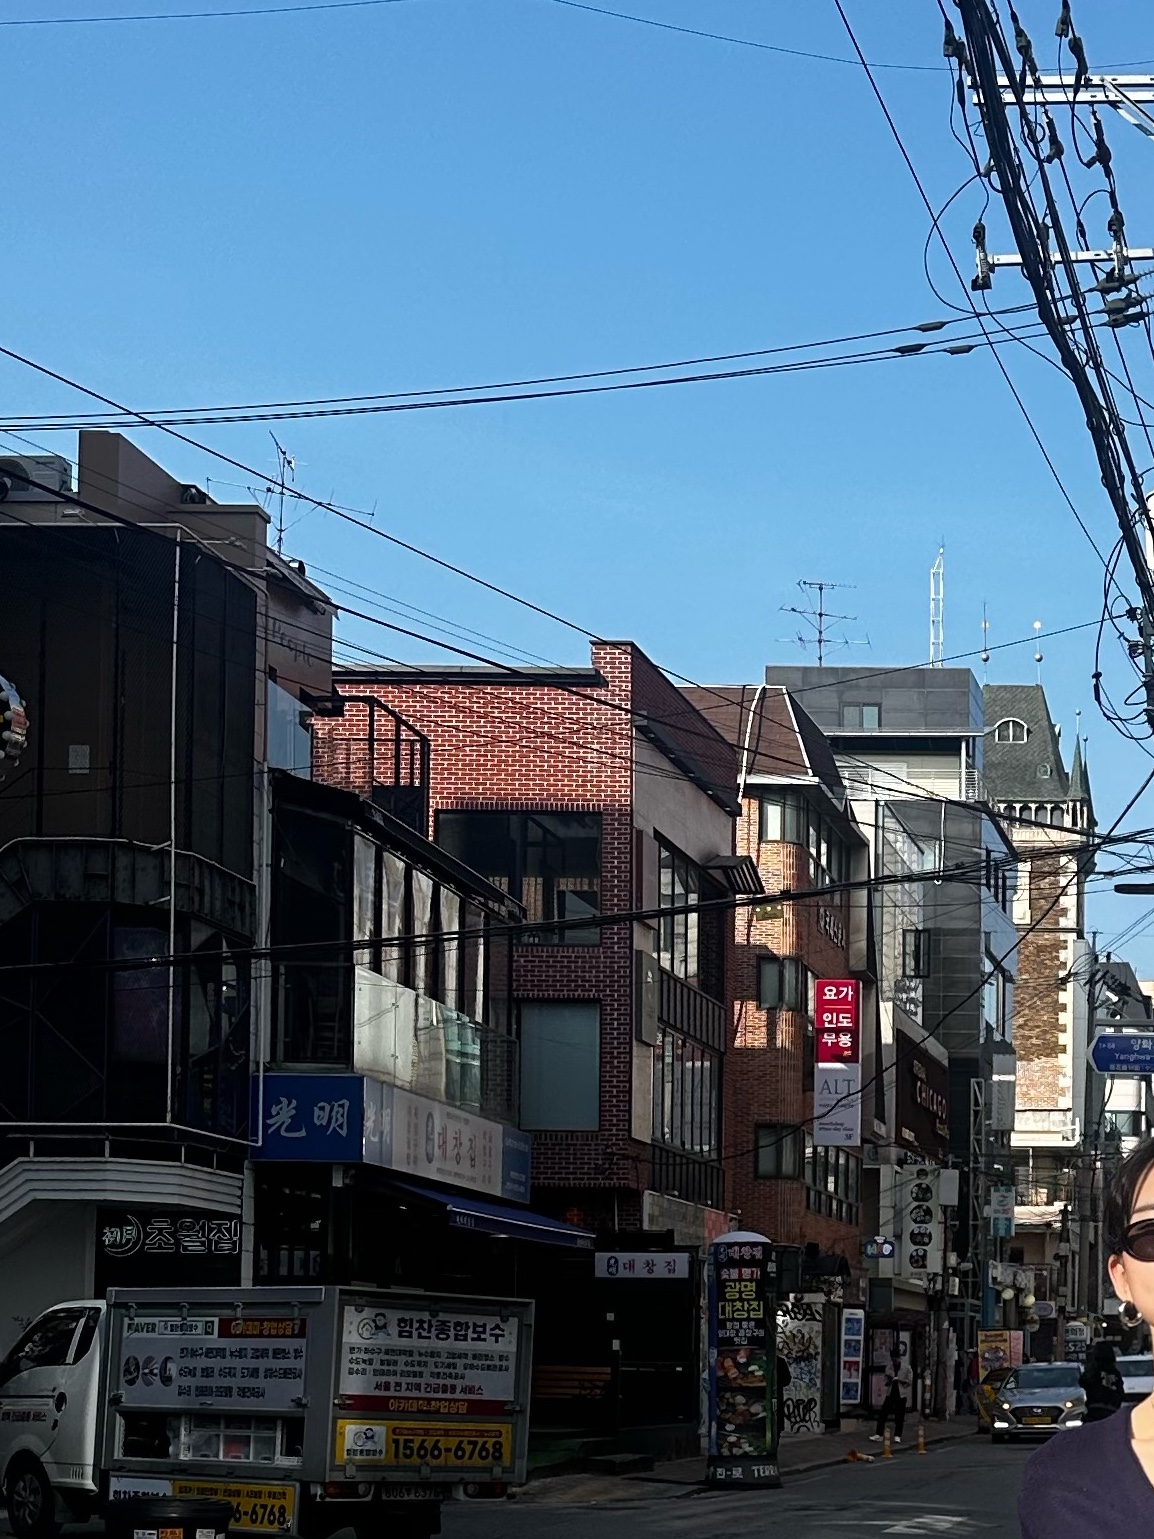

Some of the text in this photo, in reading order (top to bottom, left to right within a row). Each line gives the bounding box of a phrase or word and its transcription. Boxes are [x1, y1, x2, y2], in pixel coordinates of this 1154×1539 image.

[823, 986, 853, 1001] 요가
[823, 1012, 853, 1028] 인도
[822, 1032, 852, 1047] 무용
[819, 1079, 856, 1095] ALT
[266, 1096, 350, 1138] 光明
[145, 1219, 240, 1254] 초월집
[725, 1281, 756, 1299] 광명
[718, 1300, 764, 1319] 대창집
[397, 1317, 506, 1344] 힘찬종합보수
[405, 1382, 422, 1393] 지역
[392, 1438, 504, 1461] 1566-6768
[231, 1502, 287, 1526] 6-6768
